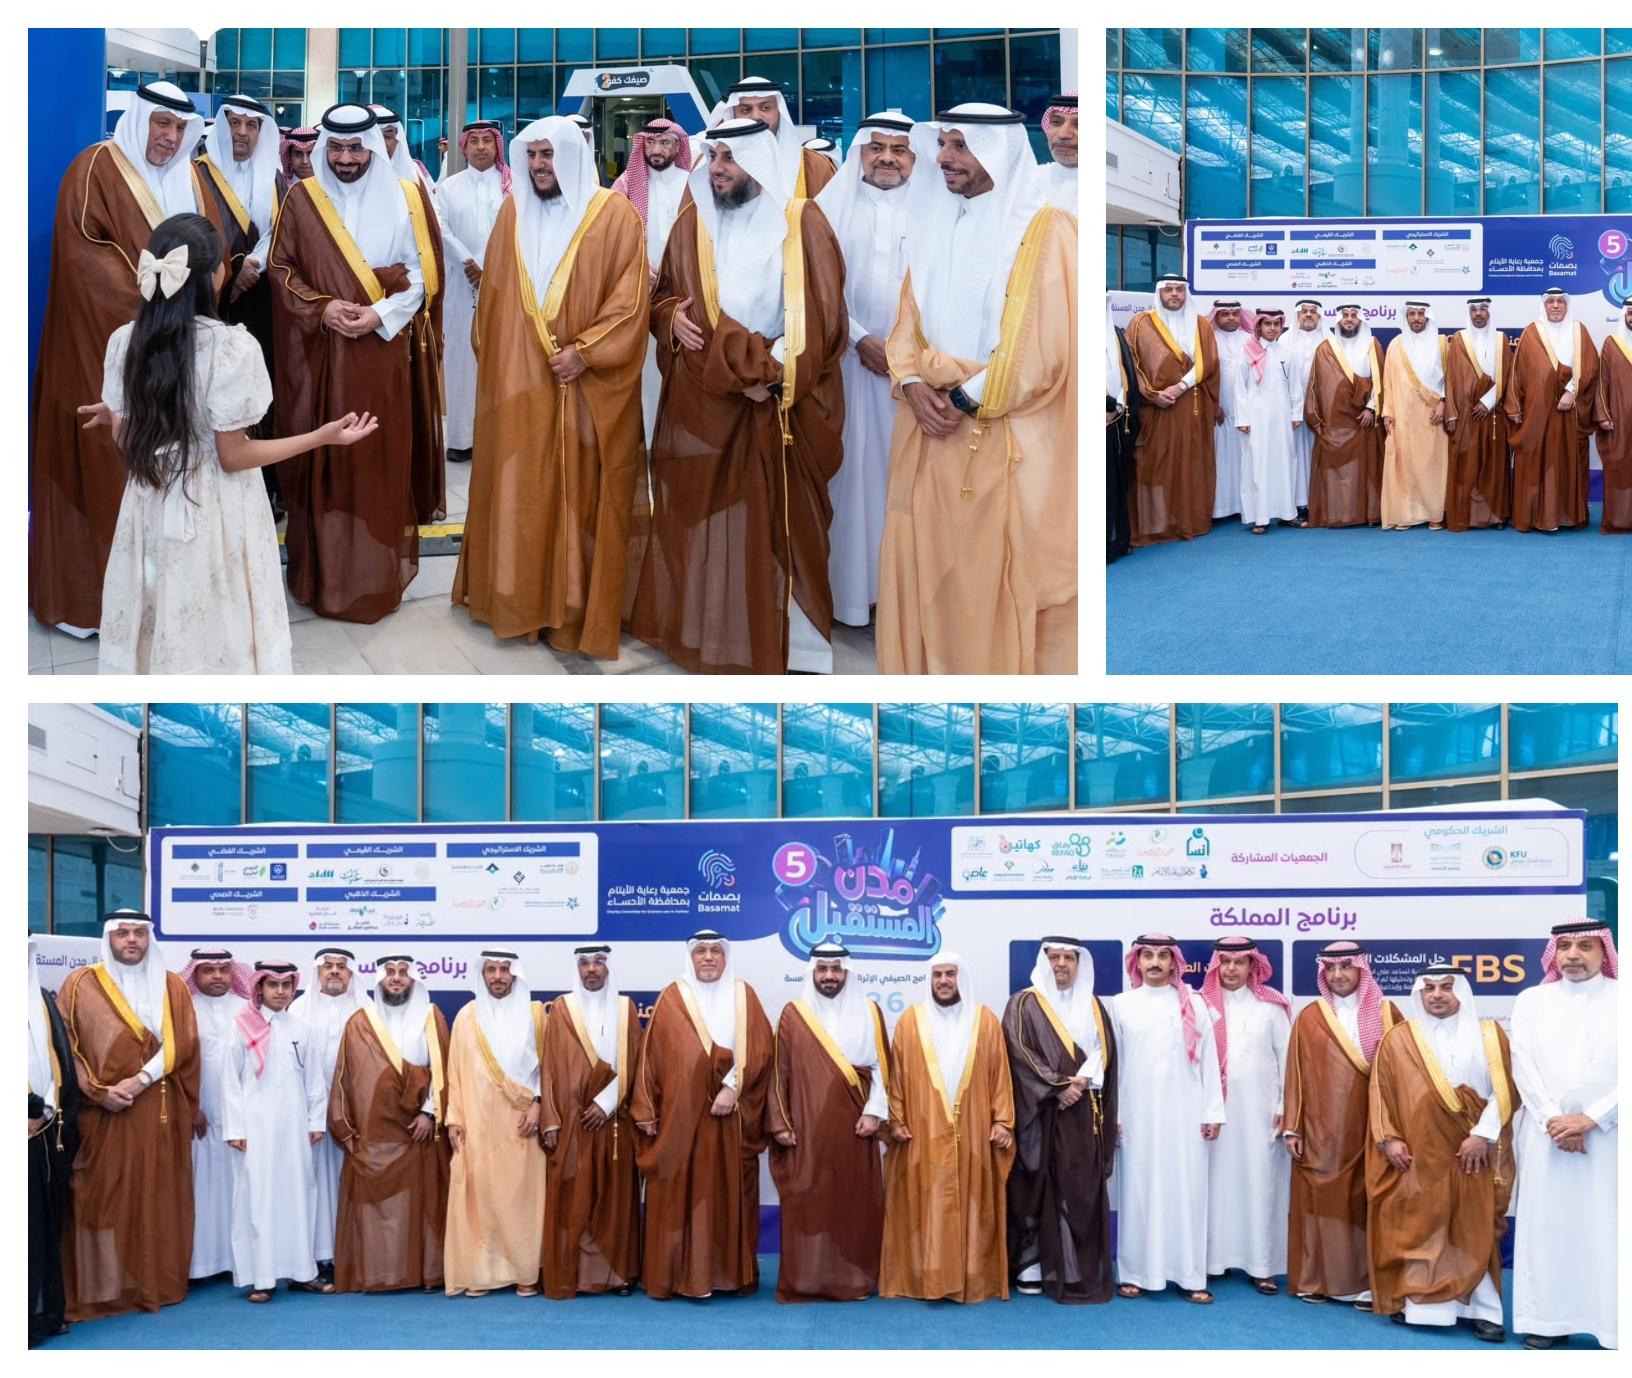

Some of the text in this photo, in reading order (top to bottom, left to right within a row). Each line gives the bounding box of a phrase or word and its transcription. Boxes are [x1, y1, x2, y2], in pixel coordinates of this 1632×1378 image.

[1606, 235, 1621, 254] 5
[1549, 261, 1578, 271] بصمات
[1423, 825, 1508, 839] الشريك الحكومي
[1230, 852, 1328, 865] الجمعيات المشاركة
[1509, 850, 1527, 859] KFU
[785, 851, 807, 878] 5
[607, 884, 690, 897] جمعية رعاية الأيتام
[834, 864, 915, 905] مدن
[606, 895, 691, 908] بمحافظة الأحساء
[697, 890, 741, 903] بصمات
[697, 904, 741, 913] Basamat
[790, 890, 939, 953] المستقبل
[1209, 906, 1358, 932] برنامج المملكة
[1374, 953, 1427, 965] المشكلات
[1428, 954, 1446, 966] حل
[879, 973, 911, 986] الصيفي
